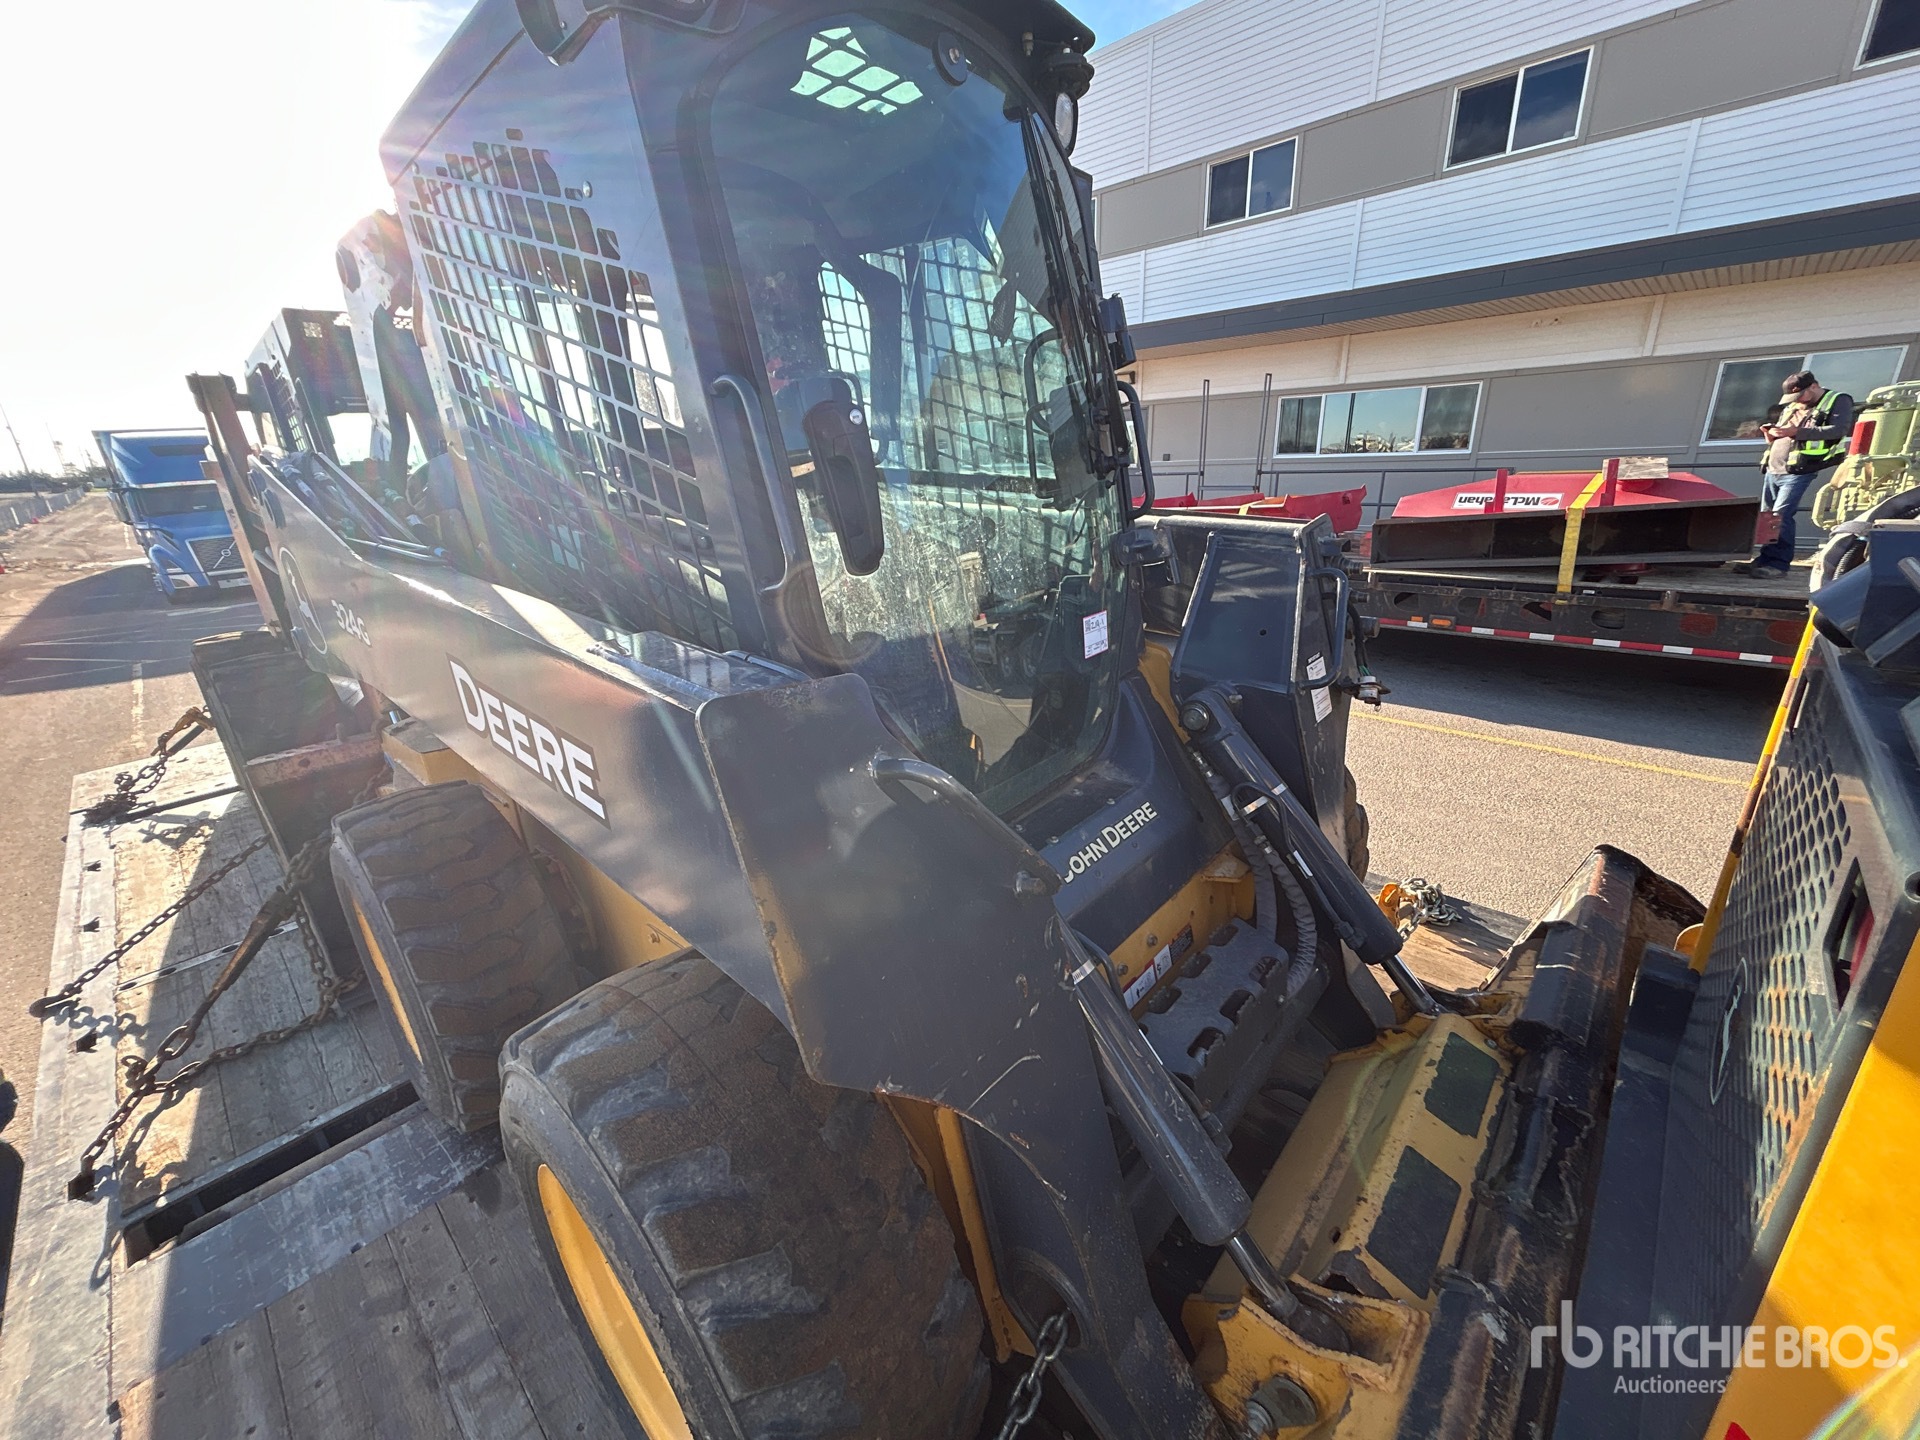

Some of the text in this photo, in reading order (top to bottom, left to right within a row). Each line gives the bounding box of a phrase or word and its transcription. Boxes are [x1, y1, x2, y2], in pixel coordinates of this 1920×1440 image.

[1458, 496, 1541, 506] McLaahan
[331, 599, 371, 646] 324G
[450, 660, 606, 820] DEERE
[1101, 802, 1158, 848] DEERE
